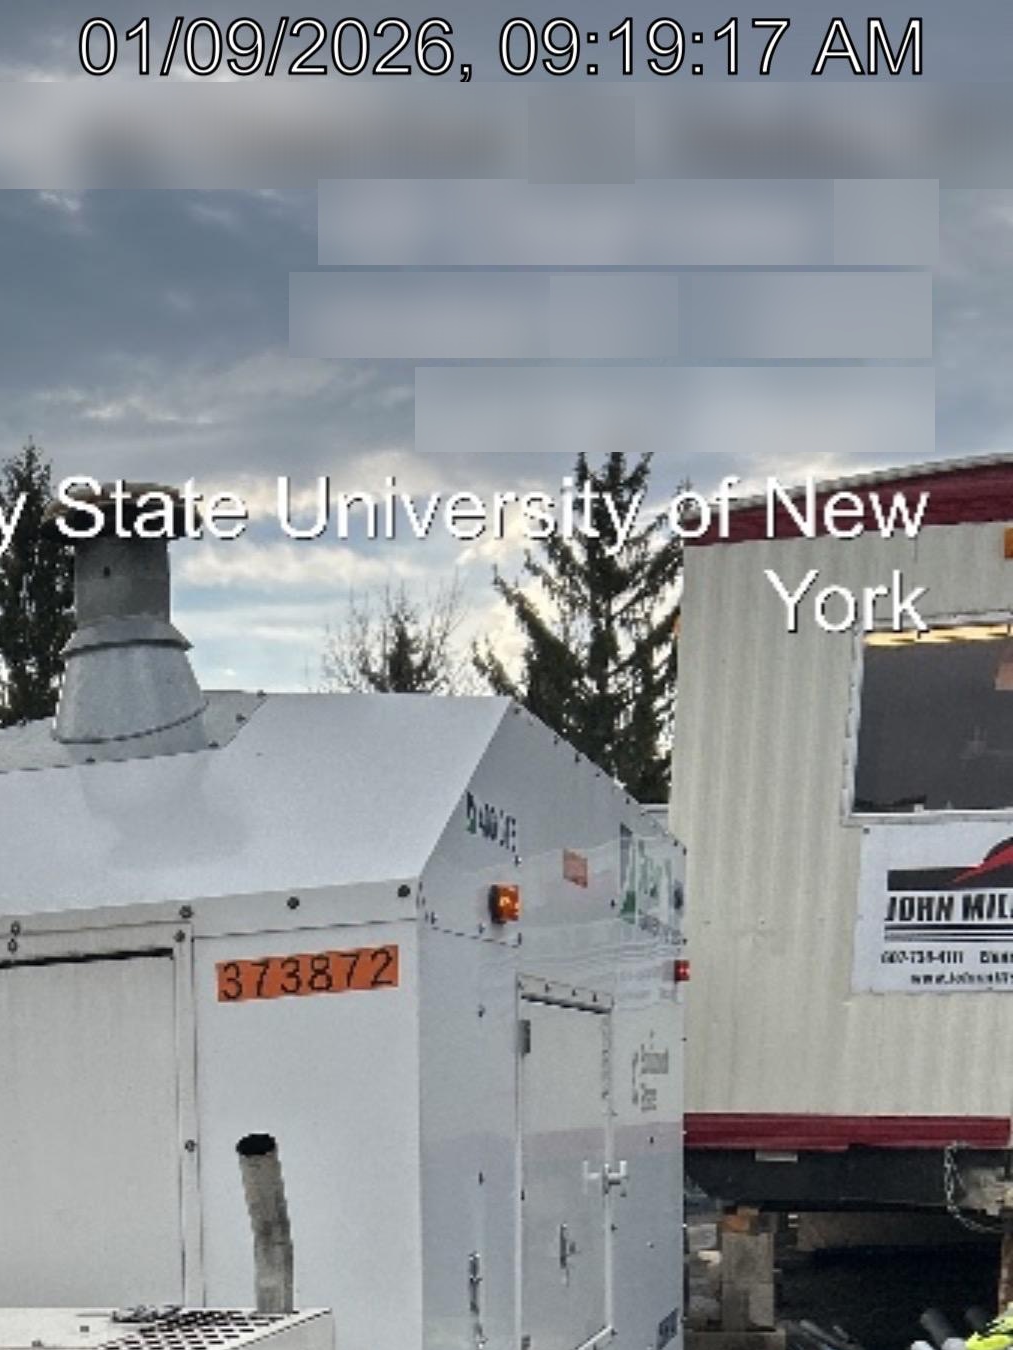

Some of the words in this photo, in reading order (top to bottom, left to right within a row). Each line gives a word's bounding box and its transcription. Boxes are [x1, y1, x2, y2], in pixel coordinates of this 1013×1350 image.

[884, 896, 954, 922] JOHN
[962, 893, 1013, 920] MIL
[221, 947, 393, 1000] 373872
